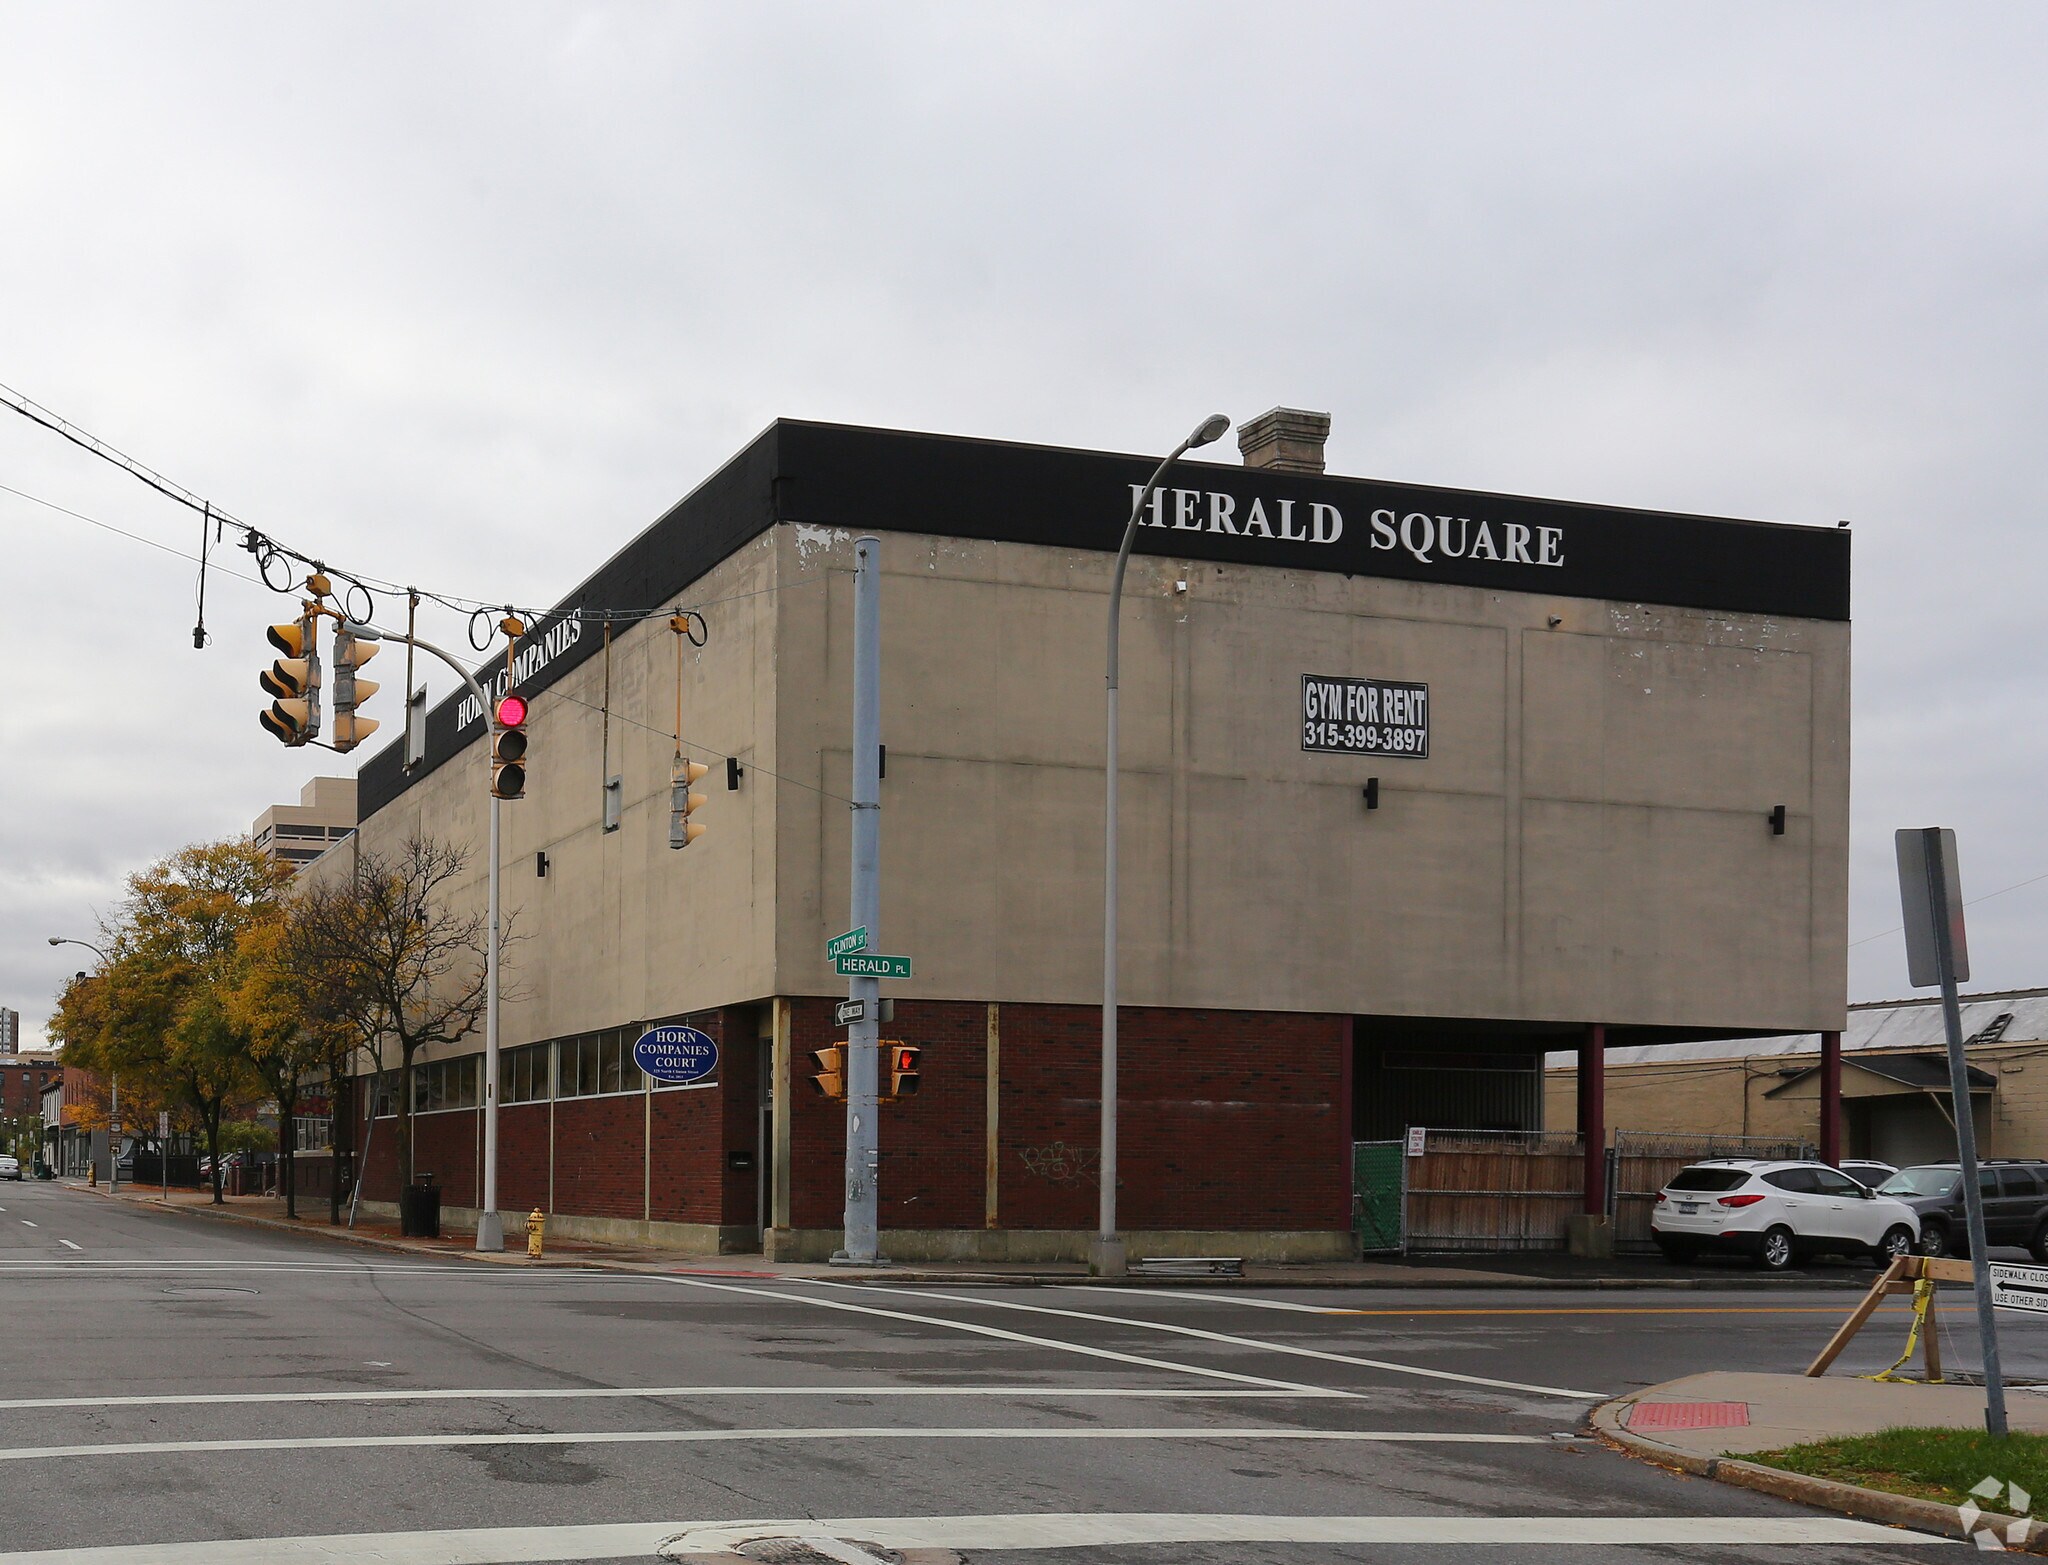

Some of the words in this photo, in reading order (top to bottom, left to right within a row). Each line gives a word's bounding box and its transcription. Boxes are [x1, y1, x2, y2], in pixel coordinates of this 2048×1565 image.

[1127, 483, 1344, 544] HERALD
[1370, 508, 1565, 568] SQUARE
[496, 607, 582, 697] COMPANIES
[1305, 682, 1342, 720] GYM
[1346, 685, 1380, 723] FOR
[1382, 688, 1426, 726] RENT
[1305, 721, 1426, 752] 315-399-3897
[833, 934, 857, 955] CLINTON
[858, 935, 864, 945] ST
[842, 958, 890, 973] HERALD
[895, 964, 907, 974] PL
[842, 1008, 850, 1017] ONE
[851, 1006, 861, 1015] WAY
[656, 1031, 697, 1043] HORN
[639, 1044, 709, 1056] COMPANIES
[655, 1057, 697, 1068] COURT
[1992, 1268, 2027, 1280] SIDEWALK
[1994, 1293, 2008, 1303] USE
[2011, 1295, 2034, 1306] OTHER
